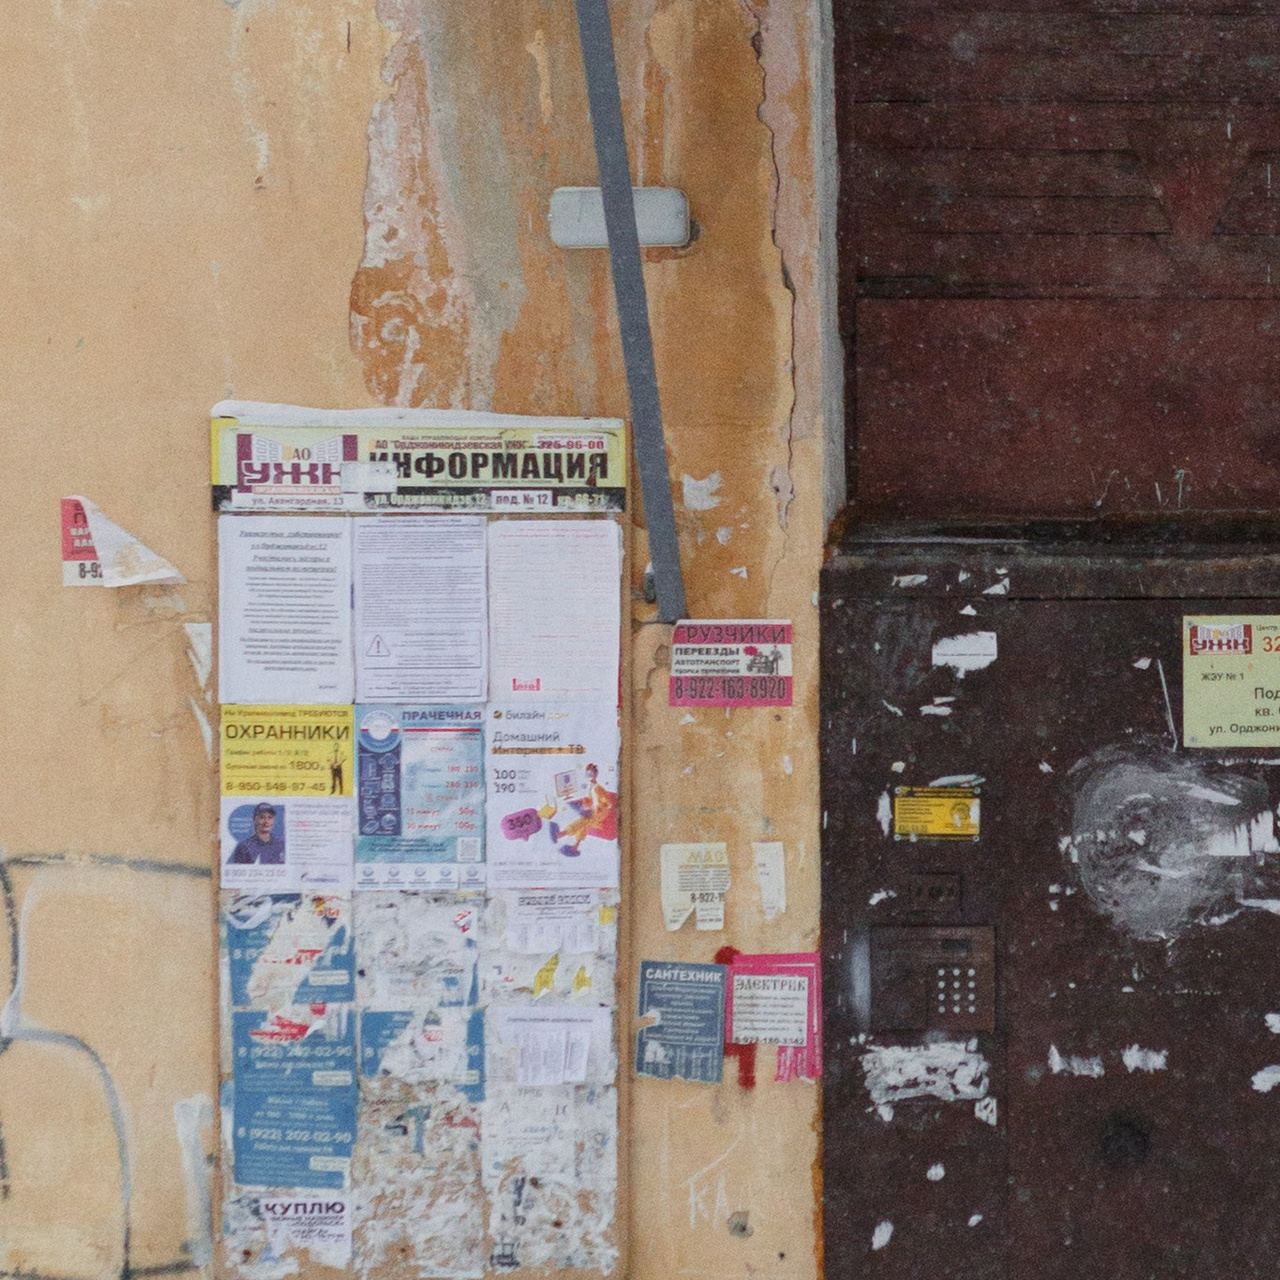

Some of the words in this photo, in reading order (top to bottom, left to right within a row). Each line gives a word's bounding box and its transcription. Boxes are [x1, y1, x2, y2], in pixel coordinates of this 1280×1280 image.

[332, 497, 344, 505] 13
[522, 494, 535, 504] №
[537, 494, 549, 504] 12
[1194, 638, 1249, 650] УЖК
[675, 647, 740, 656] ПЕРЕЕЗДЫ
[1201, 673, 1223, 681] ЖЭУ
[675, 678, 786, 699] 8-922-163-8920
[402, 711, 482, 721] ПРАЧЕЧНАЯ
[505, 710, 546, 720] билайн
[1255, 708, 1274, 717] кв.
[225, 724, 350, 740] ОХРАННИКИ
[1209, 726, 1226, 735] ул.
[492, 731, 561, 743] Домашний
[568, 745, 585, 755] ТВ
[289, 761, 320, 771] 1800
[494, 769, 517, 780] 100
[506, 813, 533, 831] 350
[645, 969, 722, 982] САНТЕХНИК
[265, 1201, 346, 1215] КУПЛЮ
